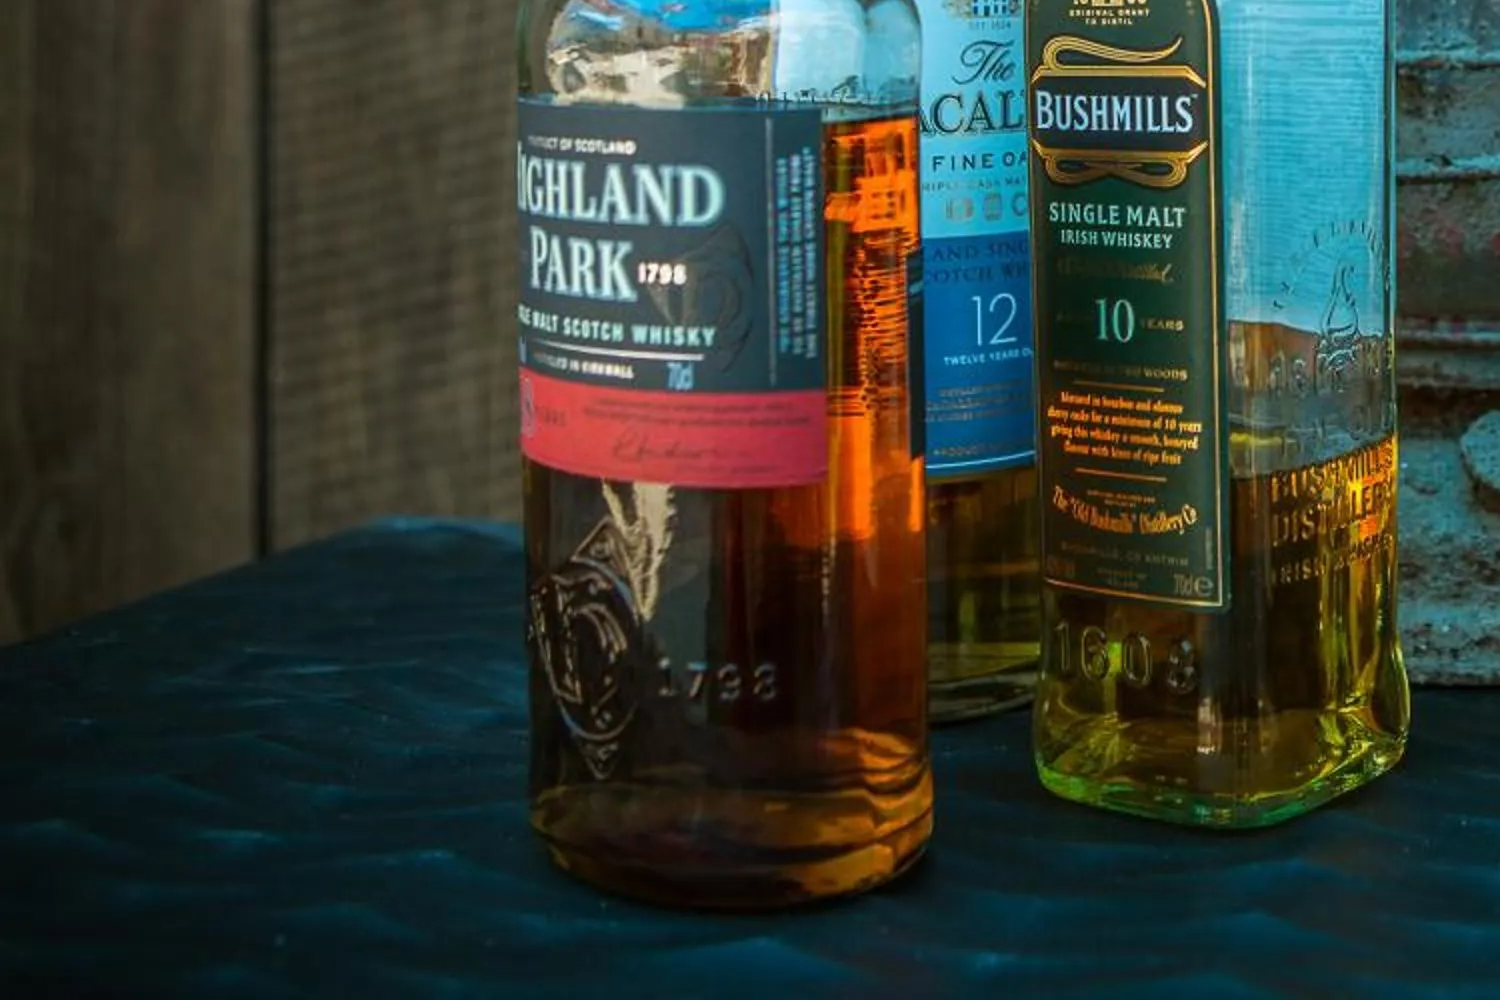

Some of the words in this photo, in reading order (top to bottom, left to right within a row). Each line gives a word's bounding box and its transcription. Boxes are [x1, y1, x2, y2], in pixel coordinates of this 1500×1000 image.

[952, 39, 1015, 86] The
[1035, 90, 1194, 133] BUSHMILLS
[931, 153, 994, 172] FINE
[1002, 150, 1027, 168] OA
[1050, 201, 1120, 226] SINGLE
[1126, 205, 1185, 229] MALT
[1061, 228, 1098, 246] IRISH
[1101, 230, 1173, 249] WHISKEY
[529, 225, 638, 303] PARK
[562, 316, 625, 342] SCOTCH
[631, 323, 716, 347] WHISKY
[972, 292, 1018, 347] 12
[1095, 297, 1136, 343] 10
[943, 353, 986, 366] TWELVE
